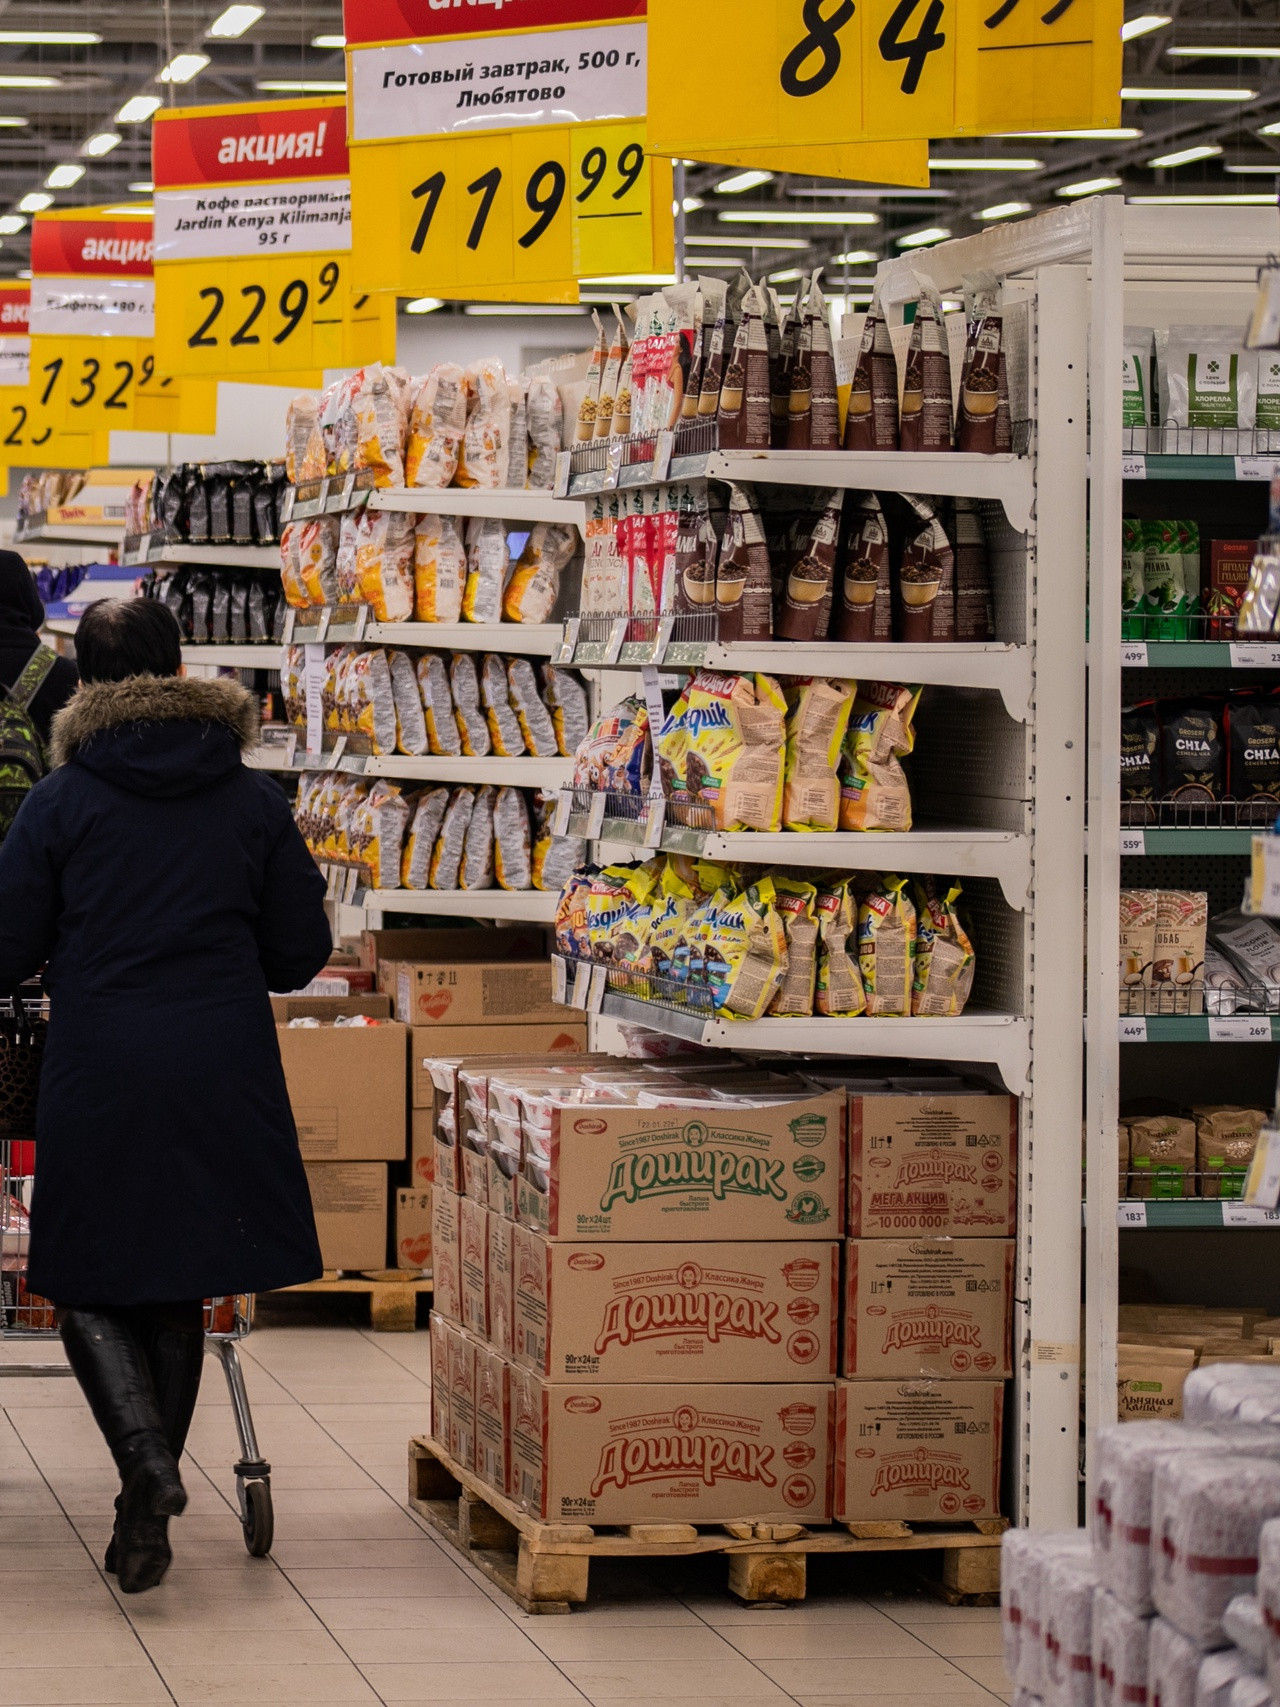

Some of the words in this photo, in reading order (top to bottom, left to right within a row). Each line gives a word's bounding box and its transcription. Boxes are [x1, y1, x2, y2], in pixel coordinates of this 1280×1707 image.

[383, 63, 474, 88] Готовый
[479, 57, 569, 80] завтрак,
[578, 50, 620, 70] 500
[625, 50, 641, 67] г,
[456, 85, 566, 108] Любятово
[218, 121, 327, 165] акция!
[196, 196, 245, 213] Кофе
[175, 217, 222, 231] Jardin
[227, 214, 274, 231] Kenya
[258, 233, 277, 245] 95
[1221, 572, 1249, 580] ГОДЖИ
[1178, 728, 1205, 736] GROSERI
[1175, 739, 1210, 751] CHIA
[1244, 748, 1280, 761] CHIA
[651, 1131, 680, 1143] Doshirak
[710, 1131, 744, 1142] Классика
[745, 1134, 770, 1147] Жанра
[600, 1150, 788, 1212] Доширак
[893, 1161, 978, 1189] Доширак
[871, 1192, 903, 1207] МЕГА
[906, 1192, 948, 1208] АКЦИЯ
[645, 1273, 674, 1285] Doshirak
[705, 1273, 739, 1285] Классика
[739, 1276, 764, 1289] Жанра
[594, 1292, 782, 1355] Доширак
[882, 1320, 981, 1354] Доширак
[641, 1416, 671, 1428] Doshirak
[701, 1416, 735, 1428] Классика
[735, 1420, 761, 1432] Жанра
[589, 1435, 778, 1498] Доширак
[870, 1463, 970, 1496] Доширак
